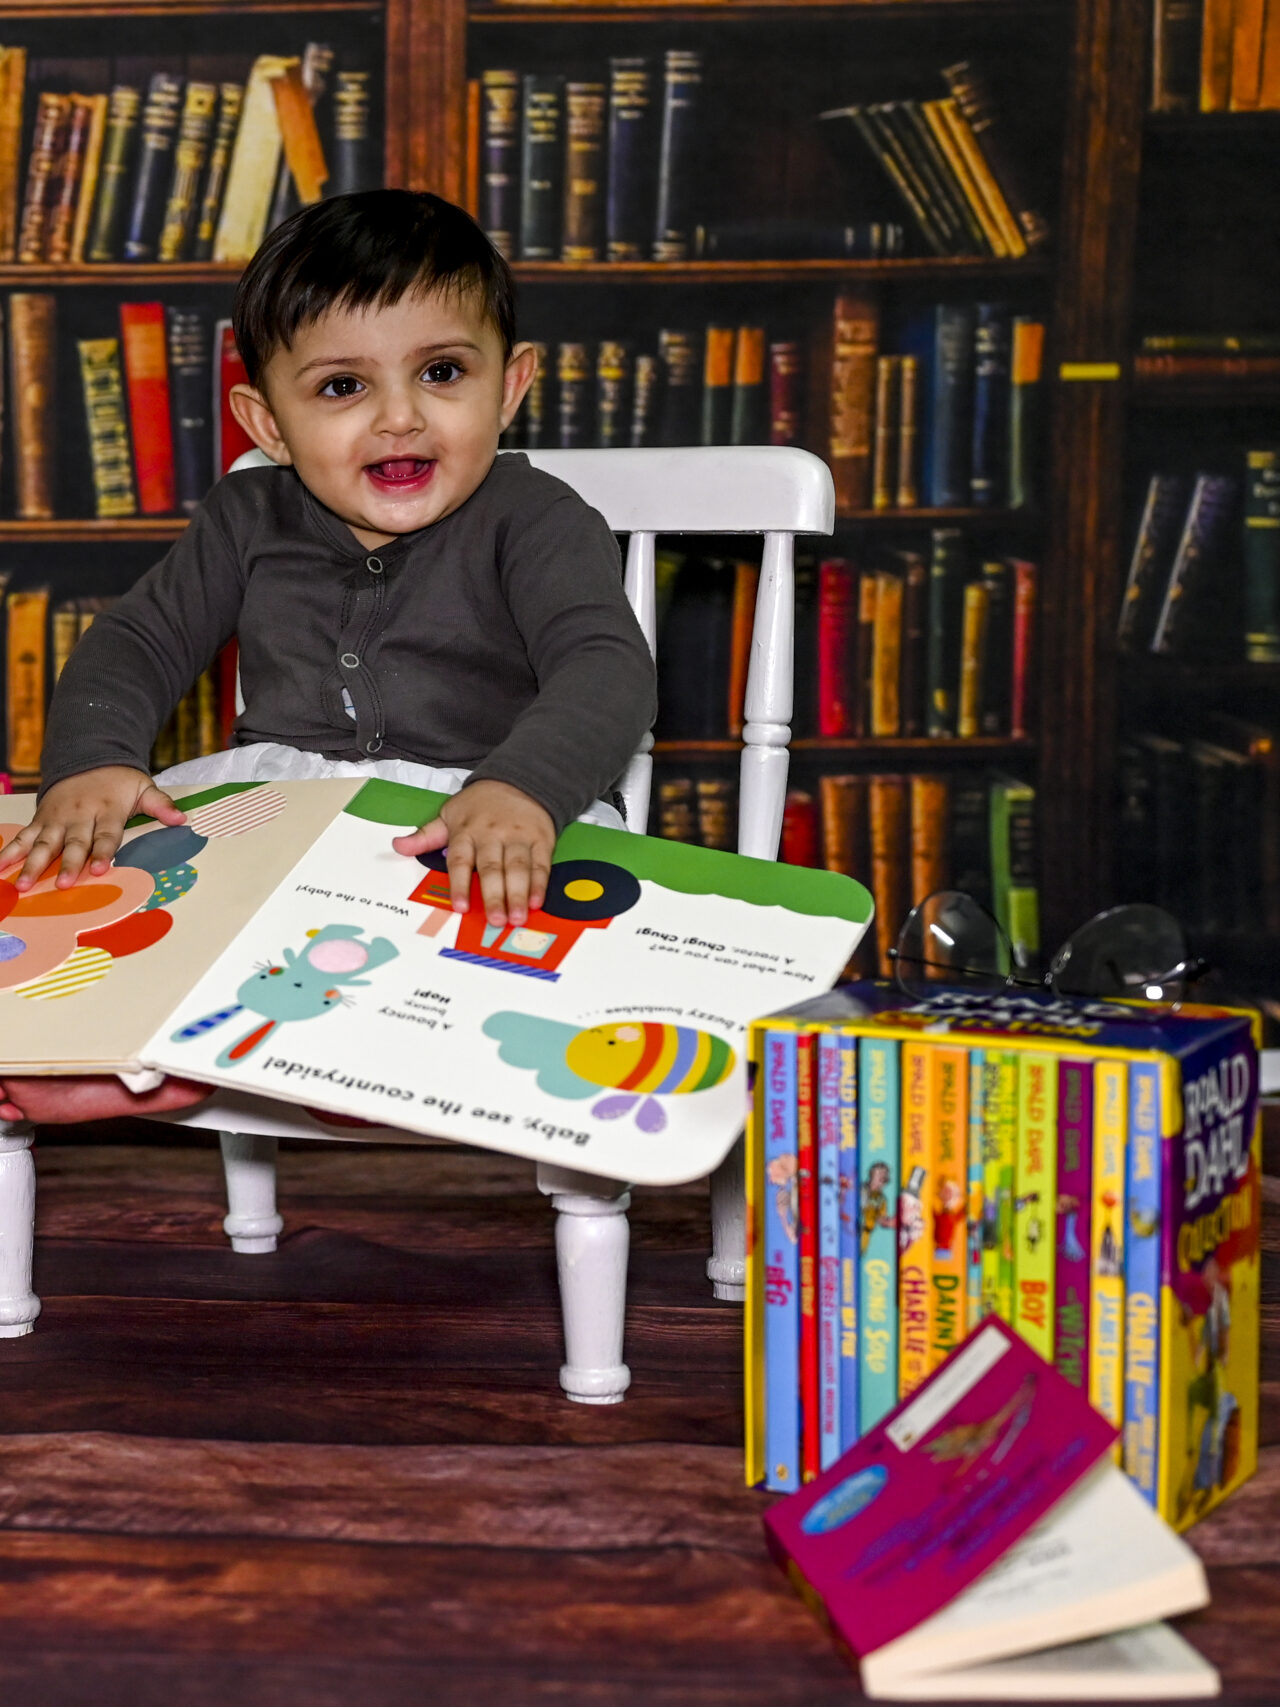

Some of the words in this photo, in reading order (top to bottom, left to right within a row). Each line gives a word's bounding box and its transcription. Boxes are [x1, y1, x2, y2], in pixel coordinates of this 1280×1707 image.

[295, 884, 333, 899] baby!
[335, 892, 356, 902] the
[359, 897, 372, 906] to
[375, 901, 409, 917] Wave
[635, 926, 679, 943] Chug!
[648, 943, 681, 953] see?
[682, 935, 726, 953] Chug!
[683, 949, 711, 961] you
[713, 955, 740, 967] can
[784, 956, 796, 966] A
[742, 961, 778, 974] what
[781, 969, 816, 984] Now
[413, 987, 451, 1004] Hop!
[378, 1005, 438, 1030] bouncy
[605, 1004, 684, 1017] bumblebee
[686, 1007, 736, 1030] buzzy
[442, 1021, 454, 1031] A
[262, 1055, 415, 1102] countryside!
[1026, 1064, 1046, 1123] ROALD
[1183, 1052, 1252, 1140] ROALD
[422, 1095, 462, 1115] the
[471, 1107, 514, 1124] see
[523, 1116, 592, 1147] Baby,
[1025, 1128, 1045, 1178] DAHL
[1183, 1114, 1250, 1211] DAHL
[863, 1258, 892, 1323] GOING
[902, 1265, 928, 1355] CHARLIE
[932, 1274, 960, 1352] DANNY
[1020, 1279, 1049, 1331] BOY
[863, 1325, 892, 1375] SOLO
